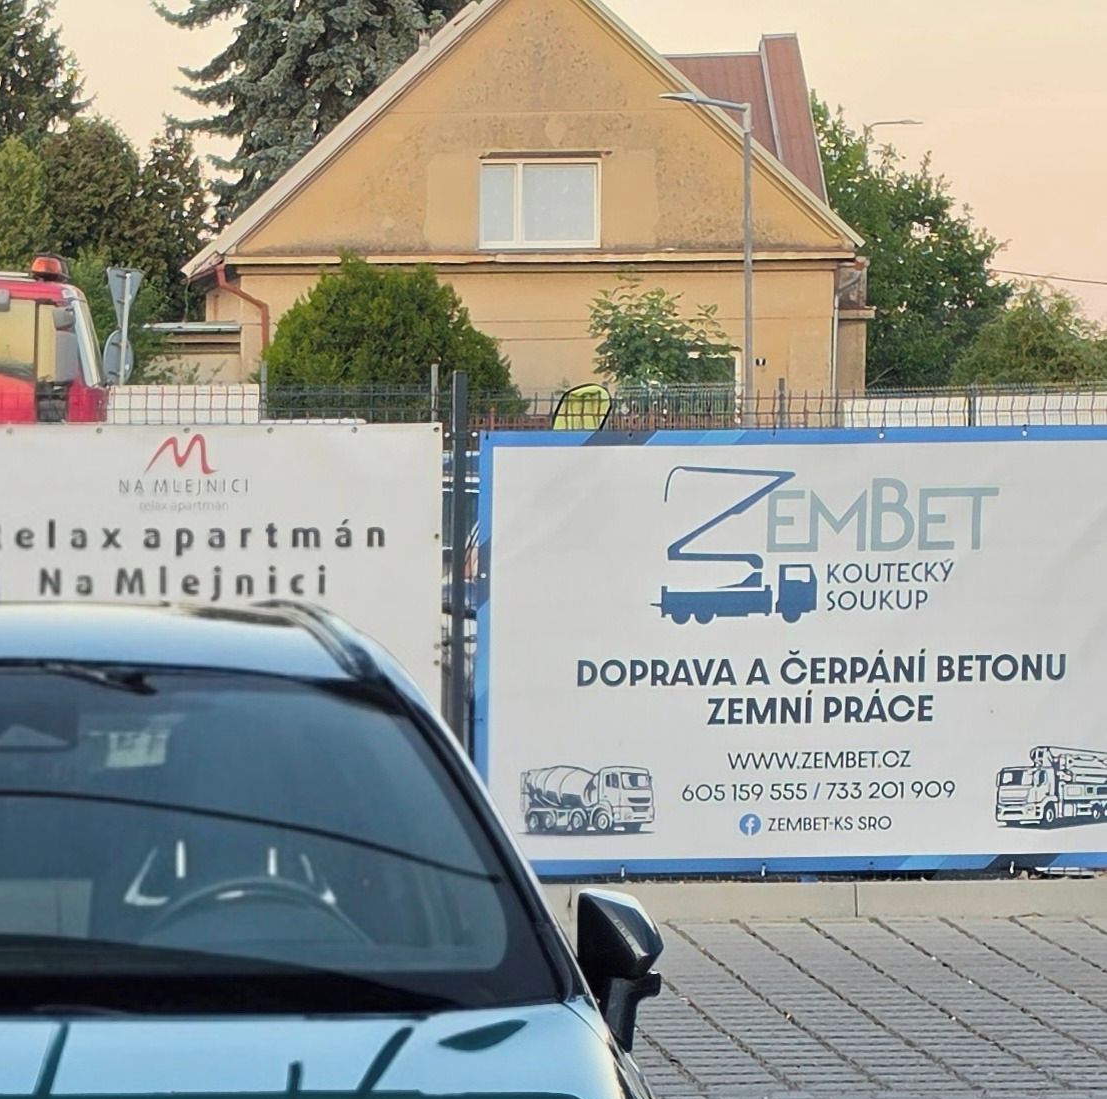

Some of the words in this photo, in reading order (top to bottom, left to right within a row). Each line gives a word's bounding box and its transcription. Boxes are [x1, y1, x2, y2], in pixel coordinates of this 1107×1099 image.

[118, 479, 145, 494] NA
[153, 478, 249, 496] MLEJNICI
[138, 499, 166, 511] relax
[664, 466, 1000, 568] ZEMBET
[143, 518, 387, 556] apartmán
[39, 567, 93, 596] Na
[115, 565, 328, 601] Mlejnici
[826, 558, 955, 584] KOUTECKÝ
[826, 589, 929, 612] SOUKUP
[577, 658, 737, 687] DOPRAVA
[745, 658, 771, 686] A
[780, 649, 926, 685] ČERPÁNÍ
[936, 653, 1068, 683] BETONU
[707, 690, 812, 726] ZEMNÍ
[823, 689, 934, 724] PRÁCE
[727, 750, 912, 770] WWW.ZEMBET.CZ
[681, 783, 726, 802] 605
[731, 783, 764, 802] 159
[769, 782, 808, 801] 555
[812, 782, 821, 801] /
[825, 781, 863, 800] 733
[868, 780, 905, 800] 201
[910, 780, 956, 799] 909
[767, 816, 854, 832] ZEMBET-KS
[857, 815, 892, 831] SRO
